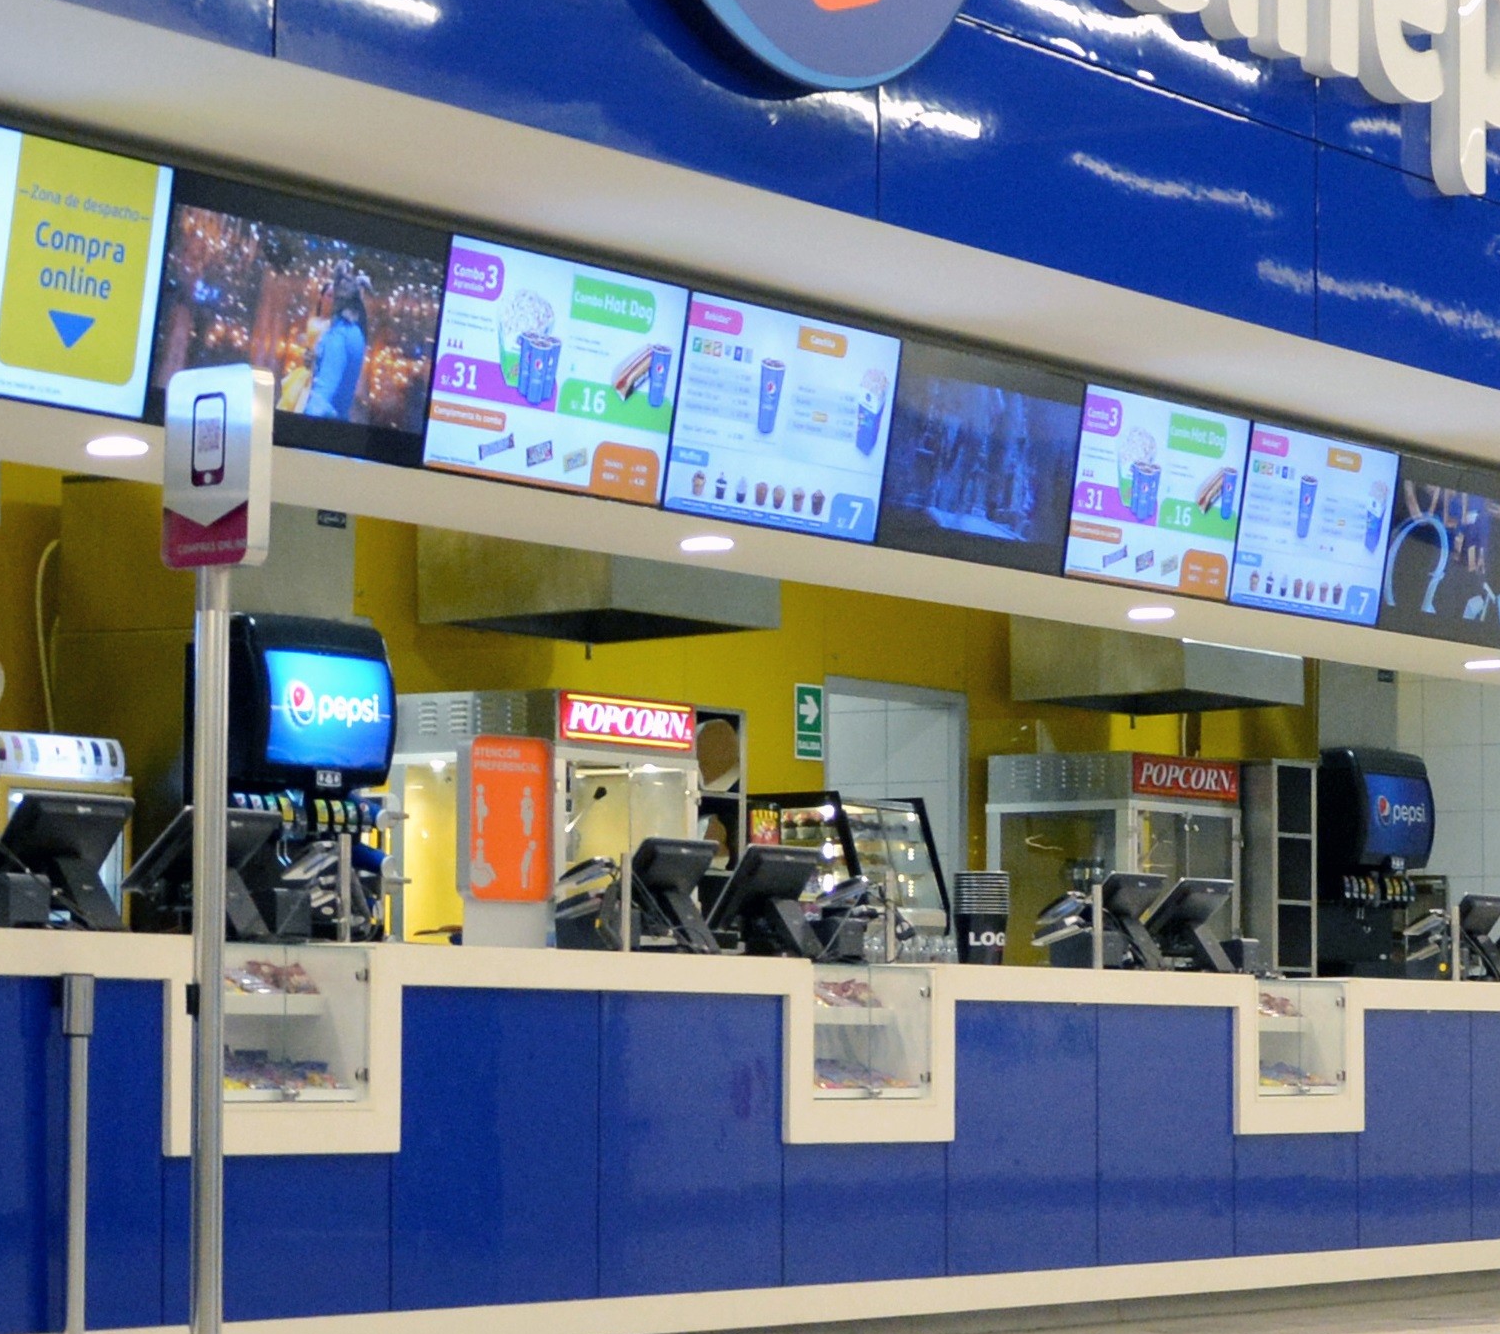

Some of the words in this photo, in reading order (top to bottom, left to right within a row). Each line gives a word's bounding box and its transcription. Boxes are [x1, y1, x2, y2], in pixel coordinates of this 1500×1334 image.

[30, 184, 61, 205] Zona
[65, 193, 80, 208] de
[83, 198, 140, 222] despacho
[35, 220, 125, 264] Compra
[40, 266, 112, 299] online
[453, 263, 485, 282] Combo
[485, 264, 499, 289] 3
[603, 294, 628, 316] Hot
[629, 300, 654, 321] Dog
[451, 361, 478, 390] 31
[581, 386, 607, 414] 16
[1084, 488, 1104, 511] 31
[848, 501, 864, 530] 7
[1174, 505, 1191, 527] 16
[1357, 592, 1370, 616] 7
[318, 693, 379, 728] pepsi
[568, 701, 689, 739] POPCORN
[1139, 762, 1231, 791] POPCORN
[1392, 802, 1426, 824] pepsi
